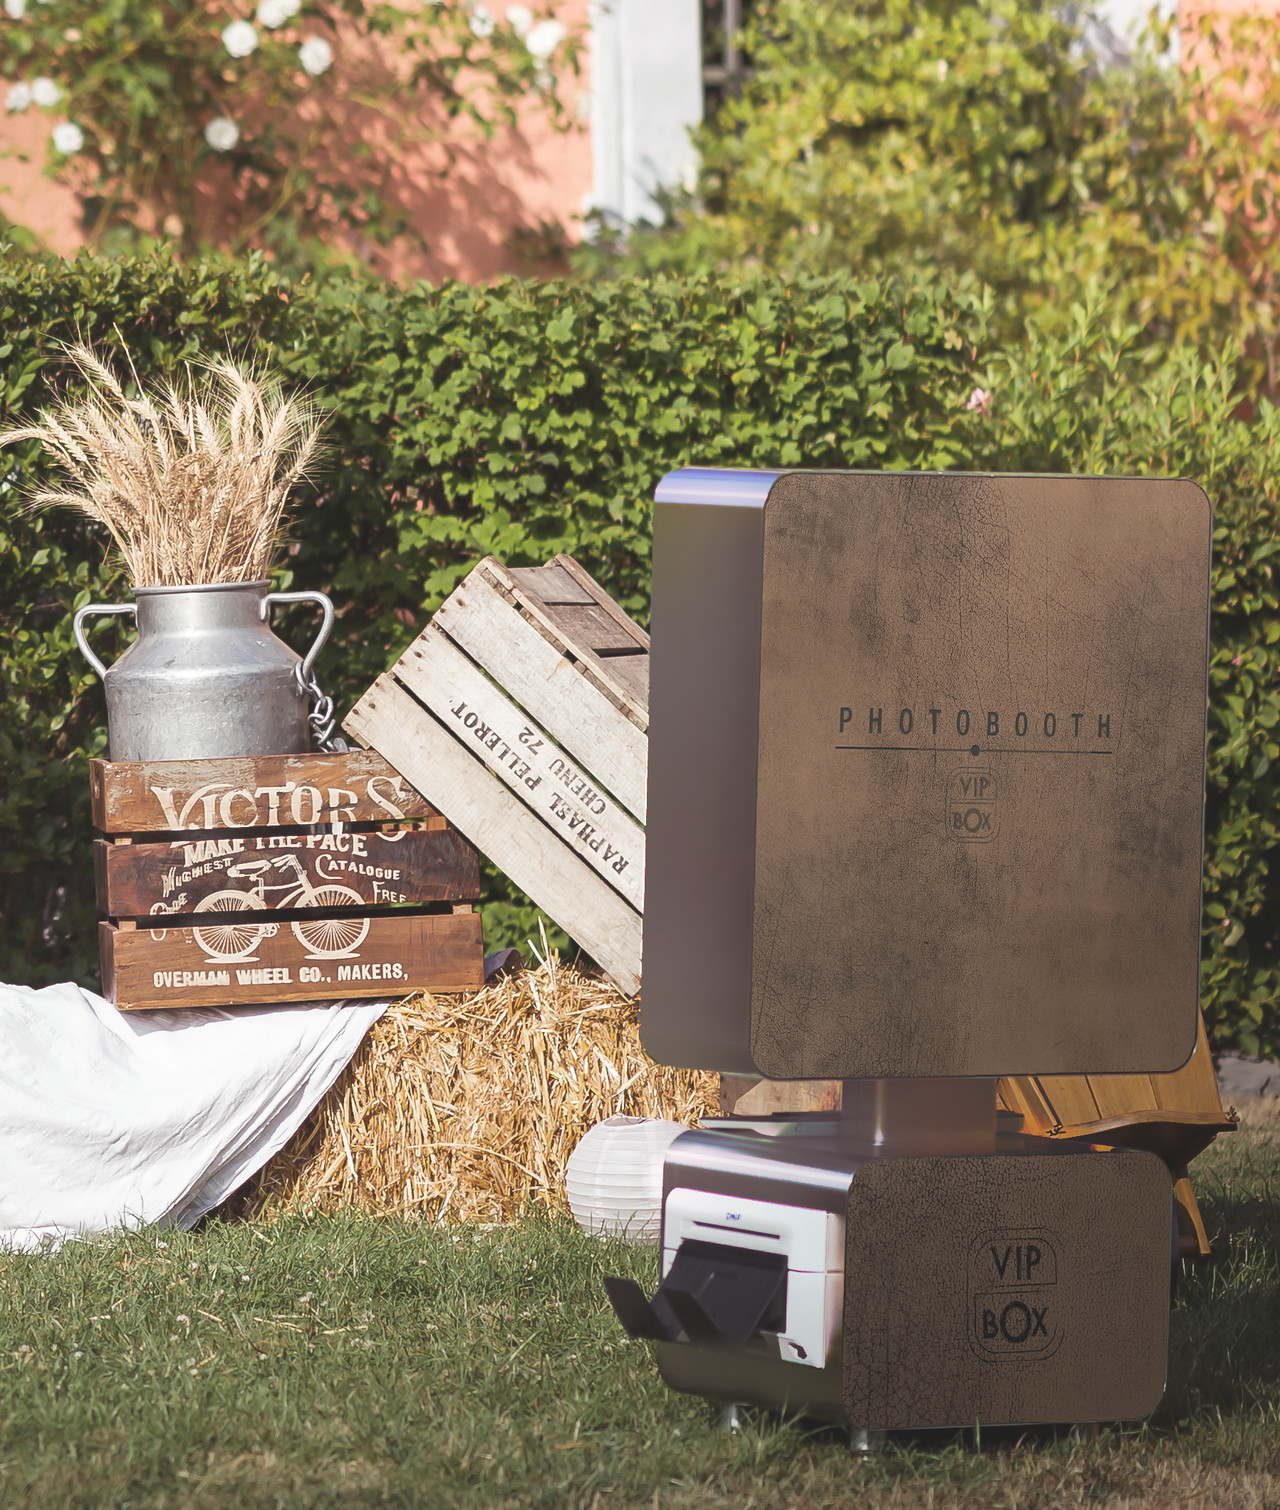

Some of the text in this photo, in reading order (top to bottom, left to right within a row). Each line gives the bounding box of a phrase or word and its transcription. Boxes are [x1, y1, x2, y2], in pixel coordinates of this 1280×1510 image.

[839, 706, 1111, 738] PHOTOBOOTH
[451, 701, 629, 875] RAPHAEL PELLEROT
[518, 726, 606, 815] CHENU 72
[959, 776, 989, 798] VIP
[150, 774, 408, 848] VICTORS
[953, 808, 991, 833] BOX
[183, 833, 368, 868] MAKE THE PACE
[315, 854, 401, 880] CATALOGUE
[153, 970, 230, 988] OVERMAN
[236, 967, 291, 986] WHEEL
[338, 963, 408, 982] MAKERS,
[989, 1244, 1041, 1281] VIP
[982, 1300, 1049, 1343] BOX
